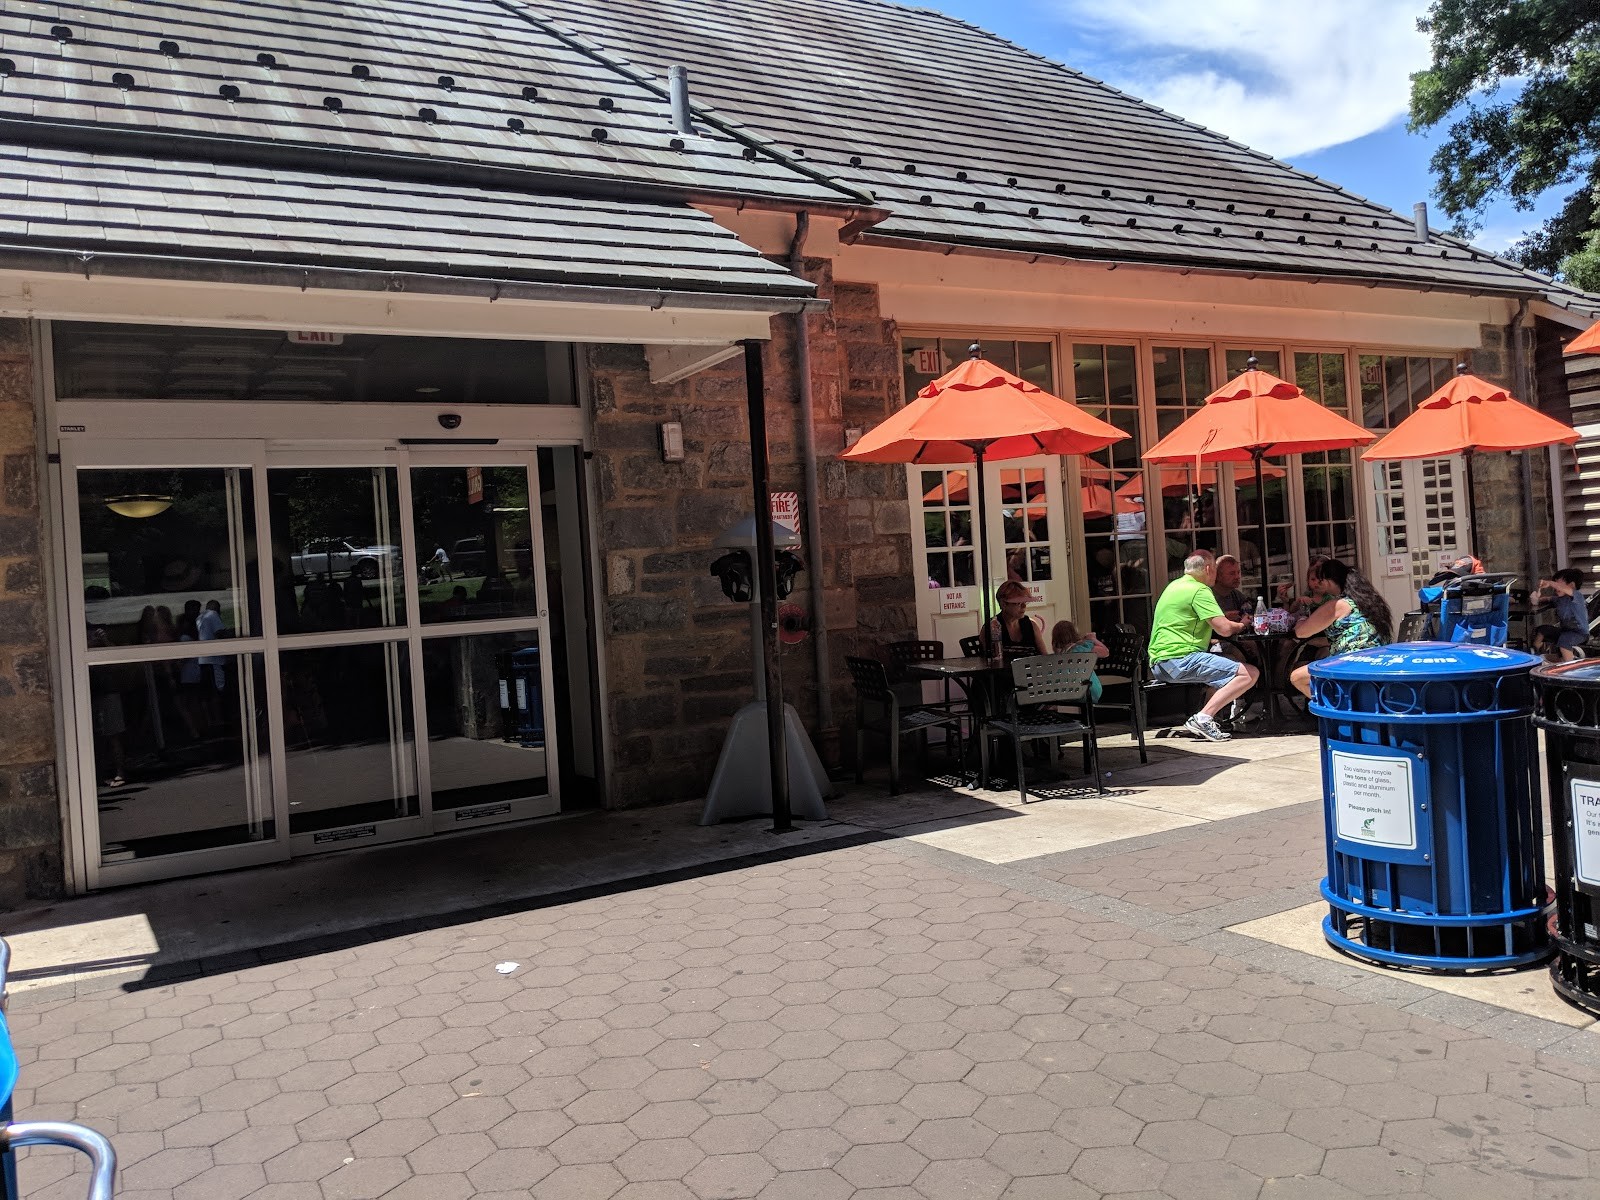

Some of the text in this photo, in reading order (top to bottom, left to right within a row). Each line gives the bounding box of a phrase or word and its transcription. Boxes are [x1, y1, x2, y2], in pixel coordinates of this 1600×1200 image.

[920, 351, 938, 371] EXI
[770, 500, 790, 512] FIRE
[943, 601, 966, 610] ENTRANCE
[1348, 803, 1366, 811] Please
[1366, 806, 1382, 814] pitch
[1586, 810, 1597, 818] Our
[1586, 819, 1596, 827] It's
